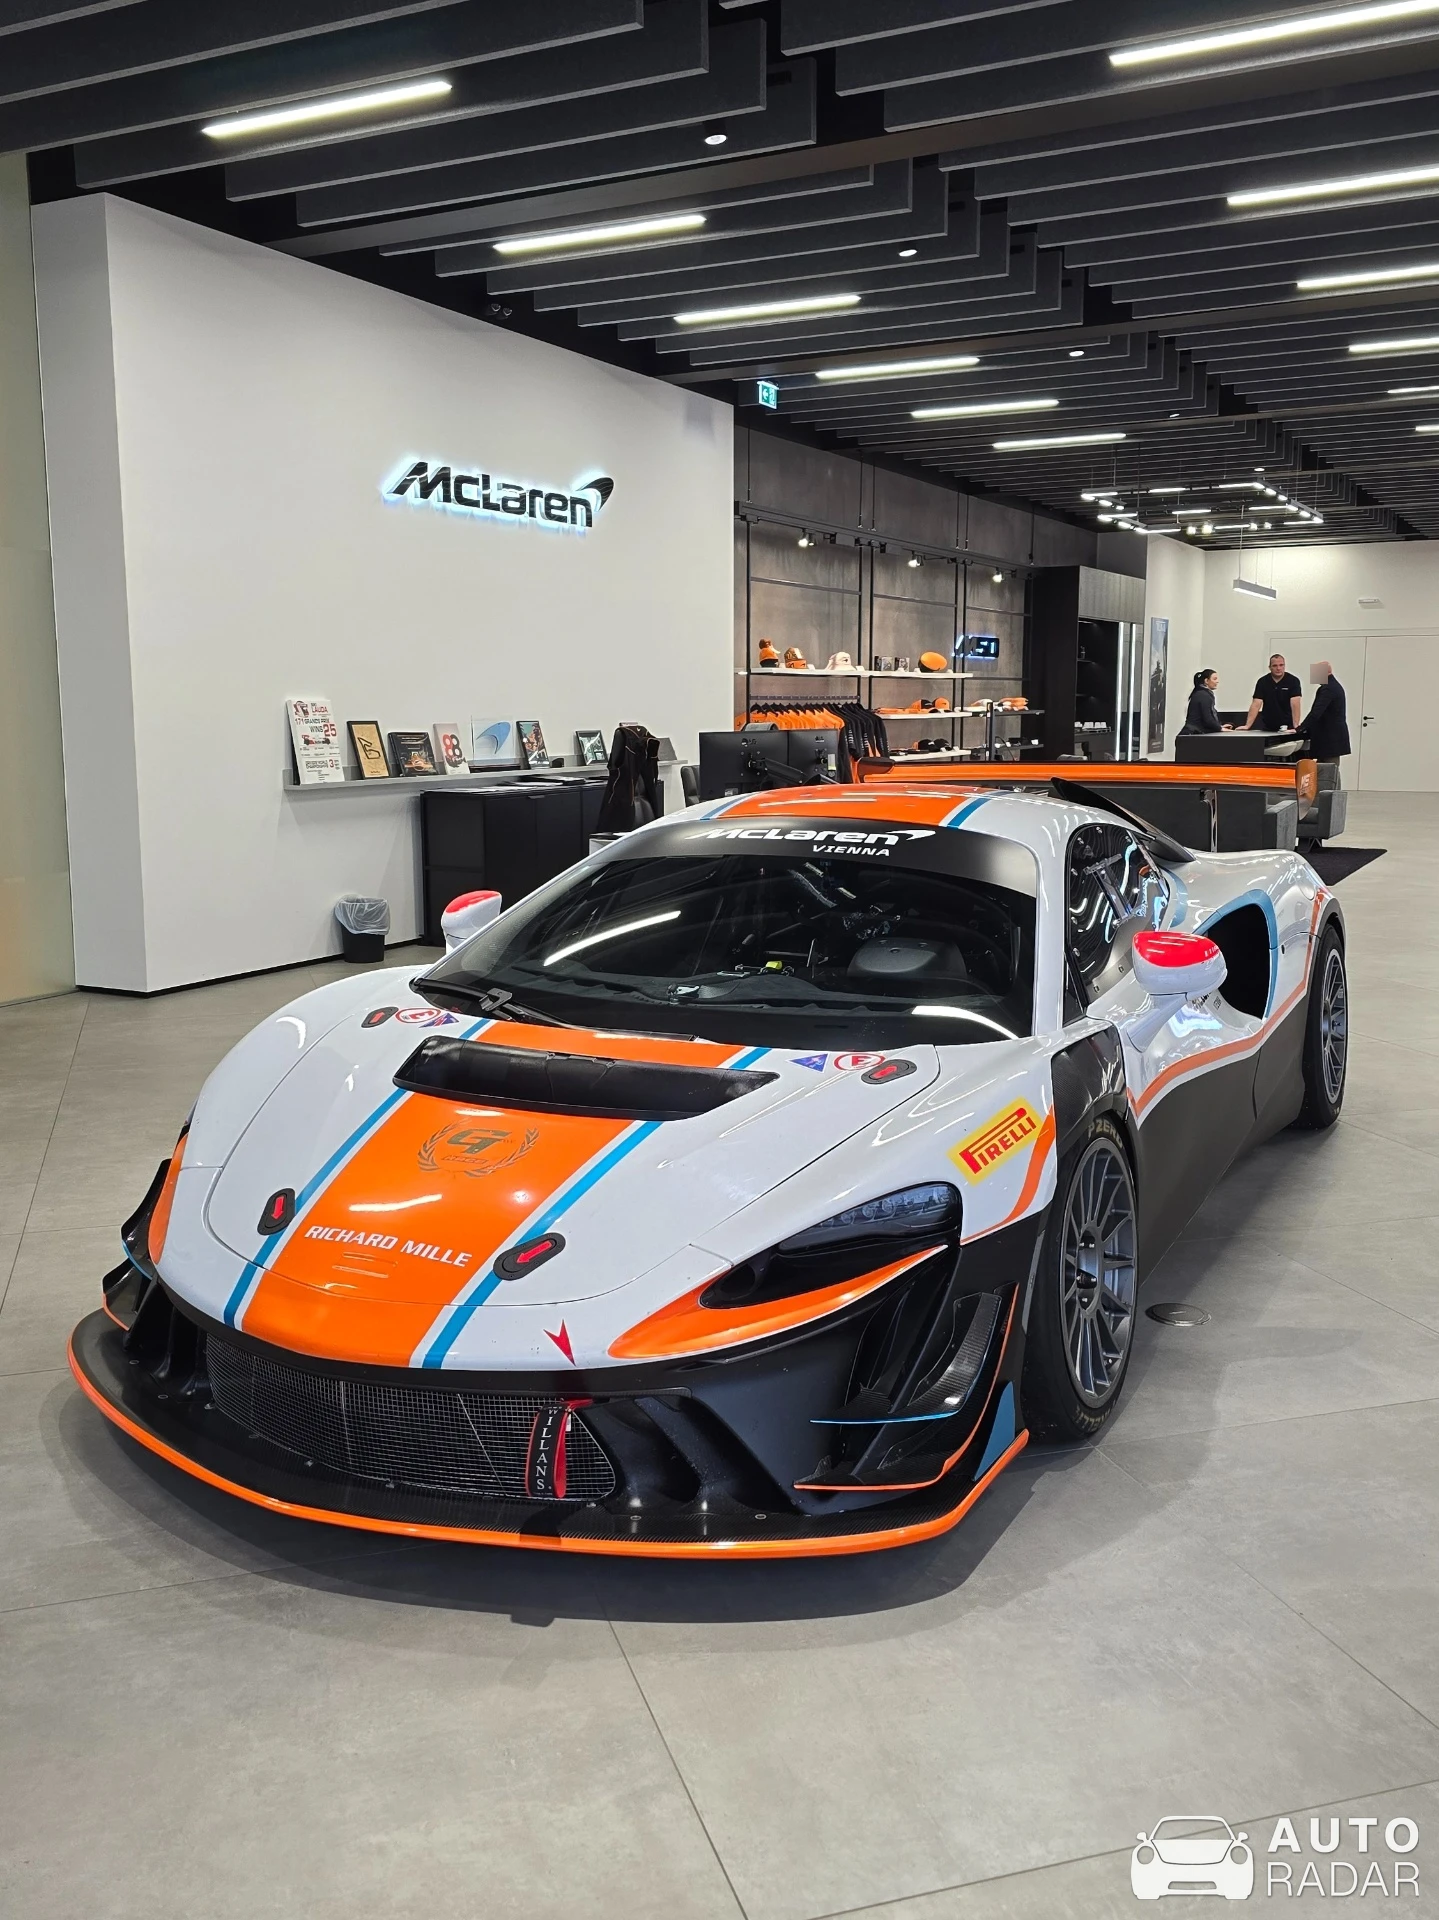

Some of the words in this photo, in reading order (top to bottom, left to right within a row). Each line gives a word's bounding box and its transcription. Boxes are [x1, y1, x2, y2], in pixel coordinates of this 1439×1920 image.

[386, 461, 593, 528] McLaren
[323, 723, 337, 737] 25
[684, 828, 900, 846] McLaren
[812, 844, 890, 857] VIENNA
[959, 1107, 1037, 1175] PIRELLI
[1087, 1121, 1096, 1141] P
[304, 1225, 399, 1250] RICHARD
[400, 1239, 473, 1268] MILLE
